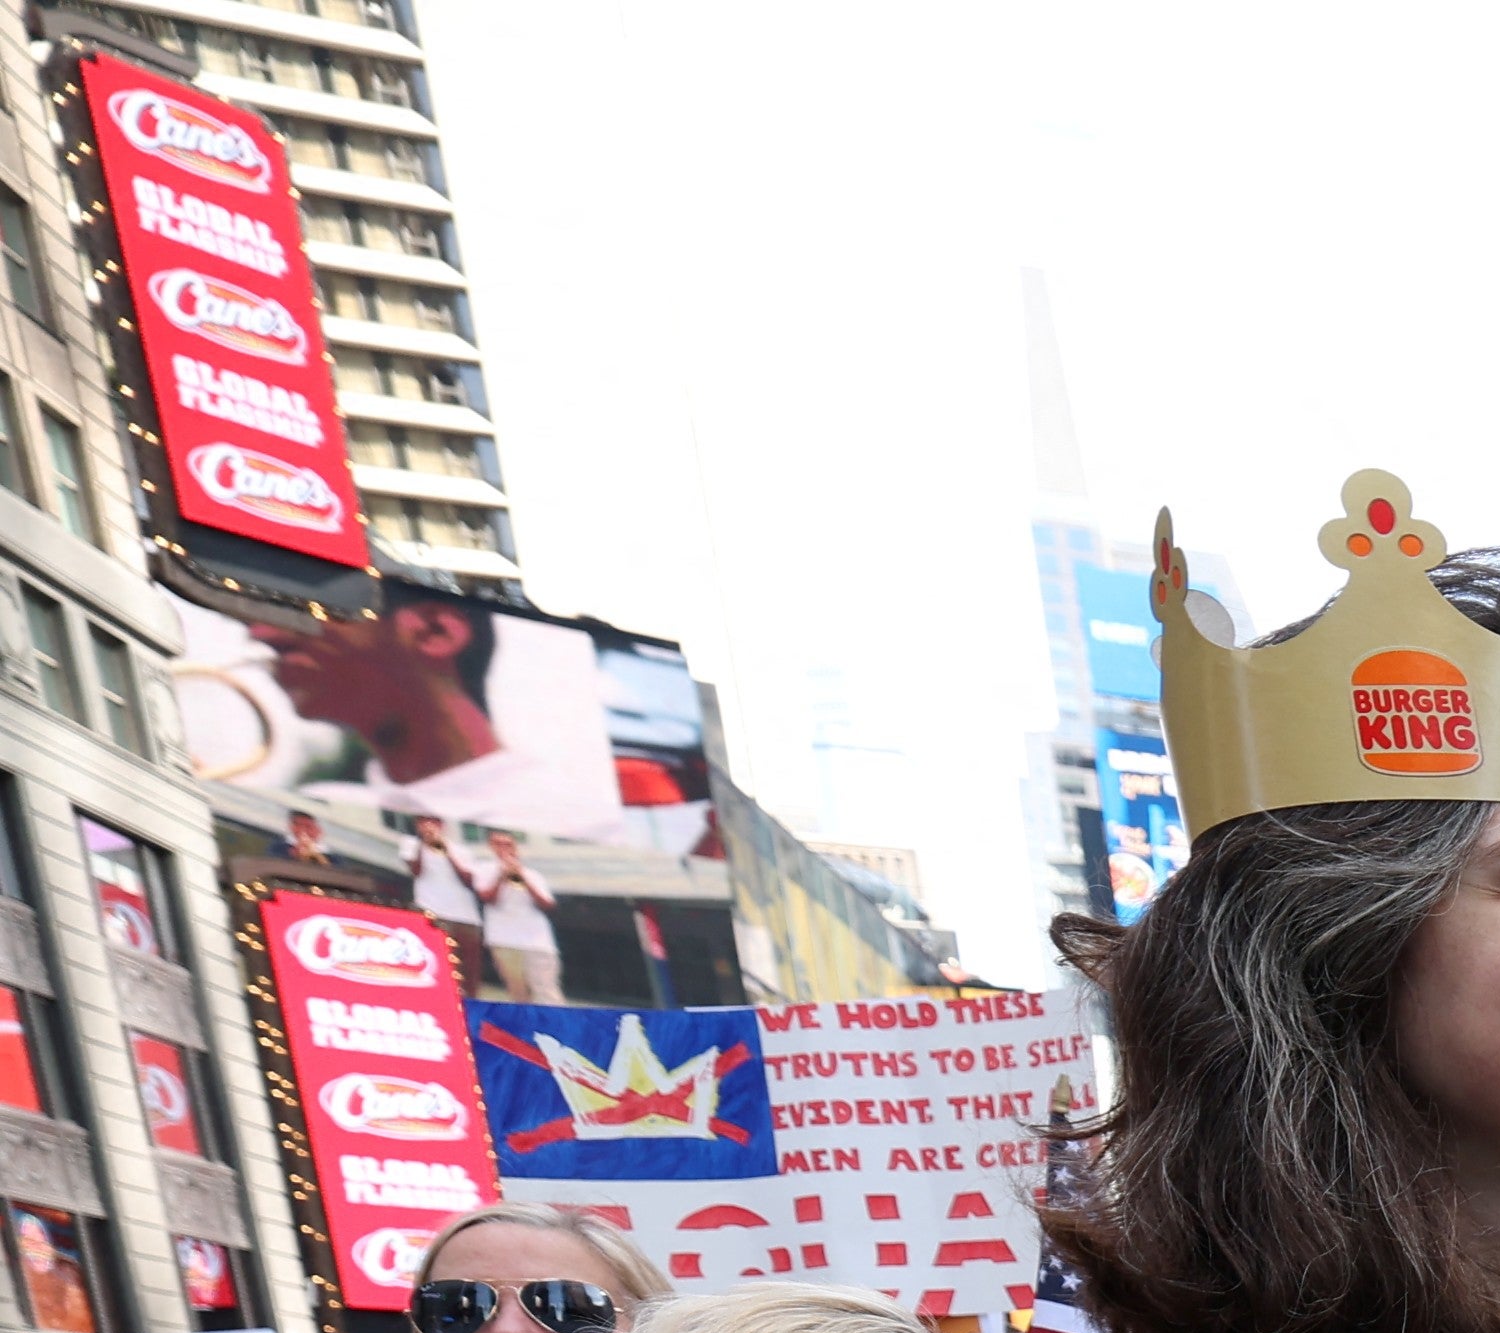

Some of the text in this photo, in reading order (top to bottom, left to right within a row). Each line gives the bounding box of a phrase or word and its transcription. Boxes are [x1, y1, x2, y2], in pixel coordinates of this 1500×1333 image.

[131, 175, 284, 255] GLOBAL
[137, 207, 289, 279] FLAGSHIP
[171, 353, 322, 425] GLOBAL
[176, 384, 326, 448] FLAGSHIP
[1352, 688, 1472, 716] BURGER
[1356, 714, 1477, 752] KING
[755, 992, 1045, 1033] WE HOLD THESE
[763, 1033, 1094, 1081] TRUTHS TO BE SELF-
[946, 1090, 1034, 1121] THAT
[1050, 1083, 1098, 1112] LL
[778, 1147, 862, 1176] MEN
[886, 1145, 966, 1172] ARE
